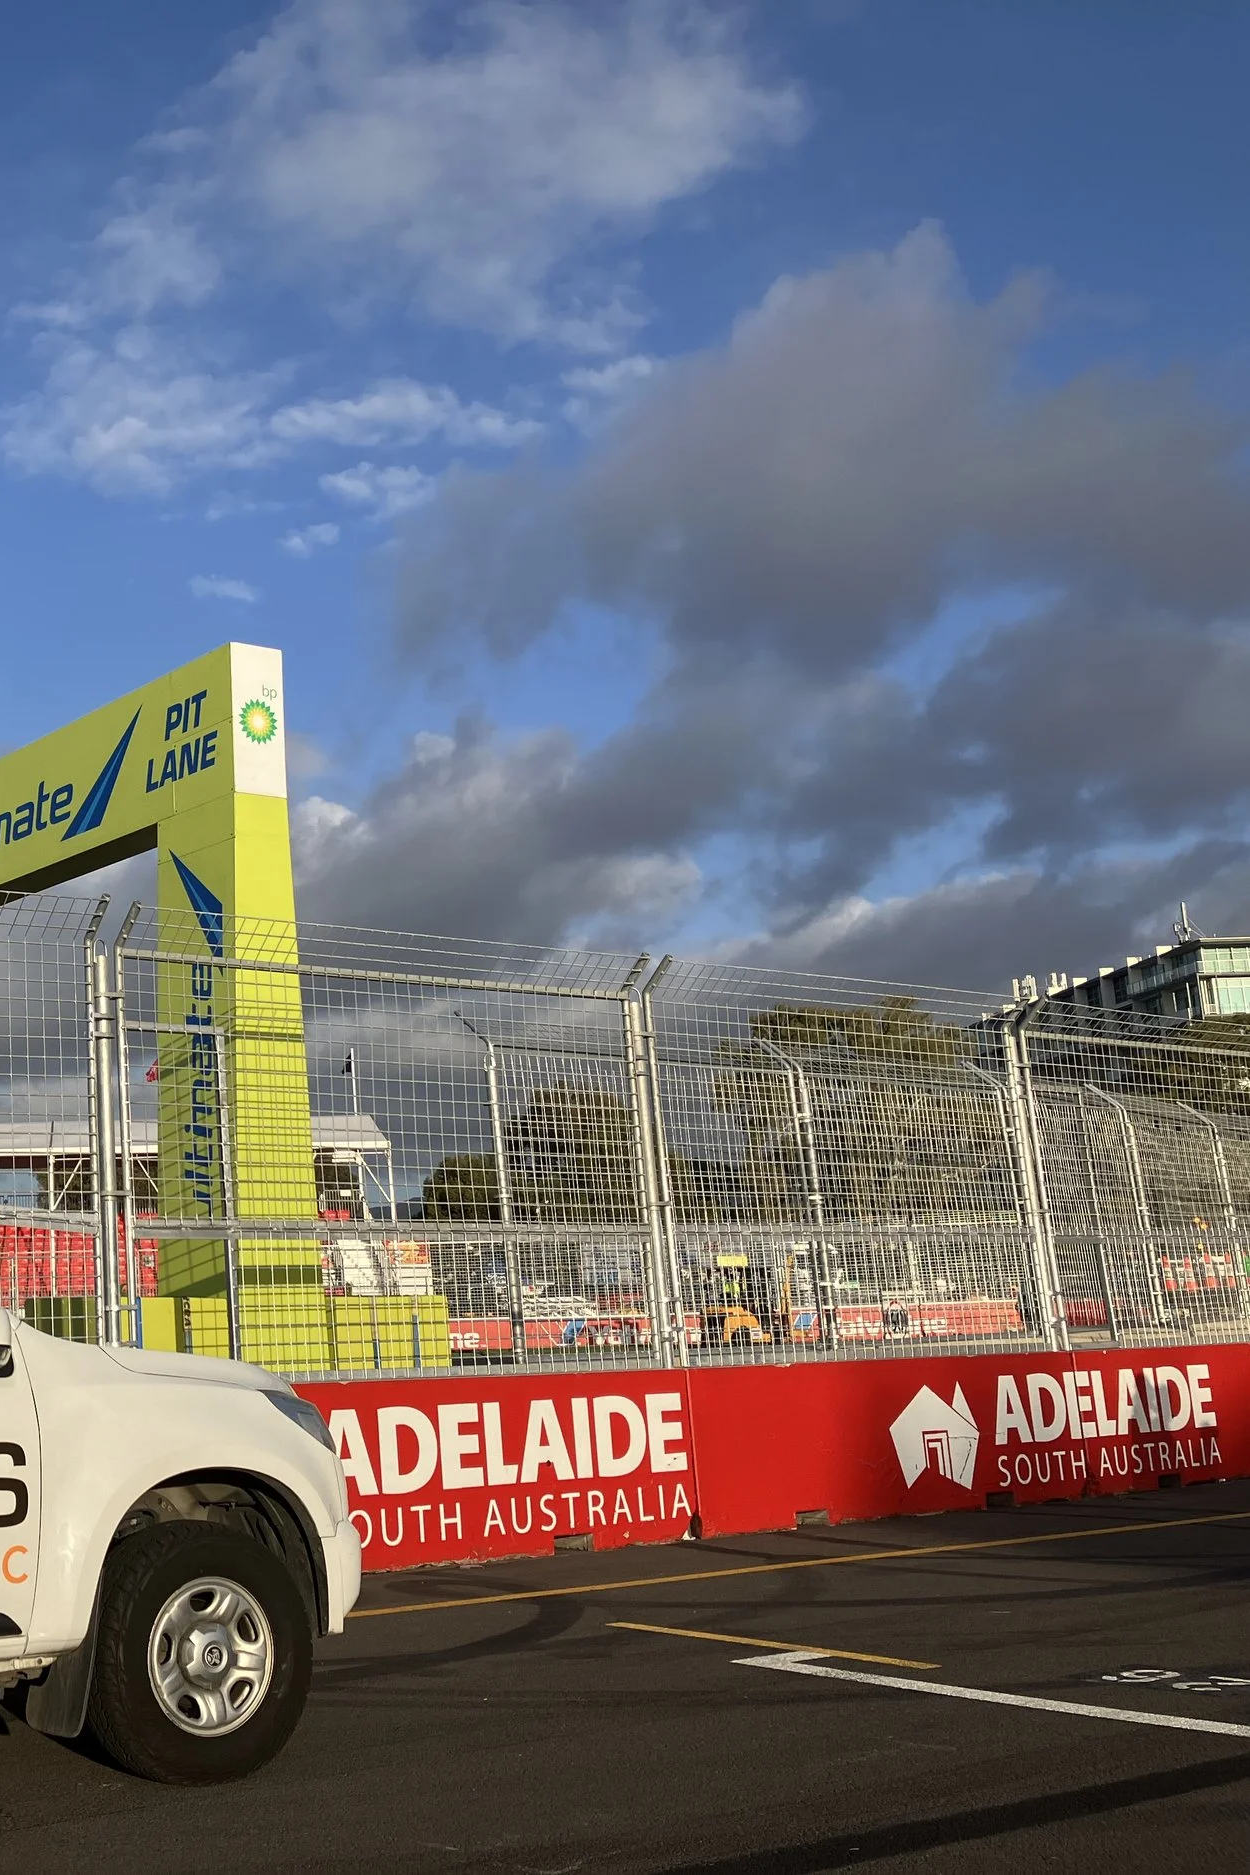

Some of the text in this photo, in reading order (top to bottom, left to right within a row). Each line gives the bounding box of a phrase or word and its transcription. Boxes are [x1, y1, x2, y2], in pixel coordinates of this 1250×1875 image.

[164, 689, 208, 742] PIT
[261, 684, 278, 699] bp
[145, 729, 219, 794] LANE
[995, 1363, 1218, 1446] ADELAIDE
[328, 1392, 688, 1496] ADELAIDE
[997, 1437, 1223, 1487] SOUTH AUSTRALIA
[483, 1483, 693, 1538] AUSTRALIA
